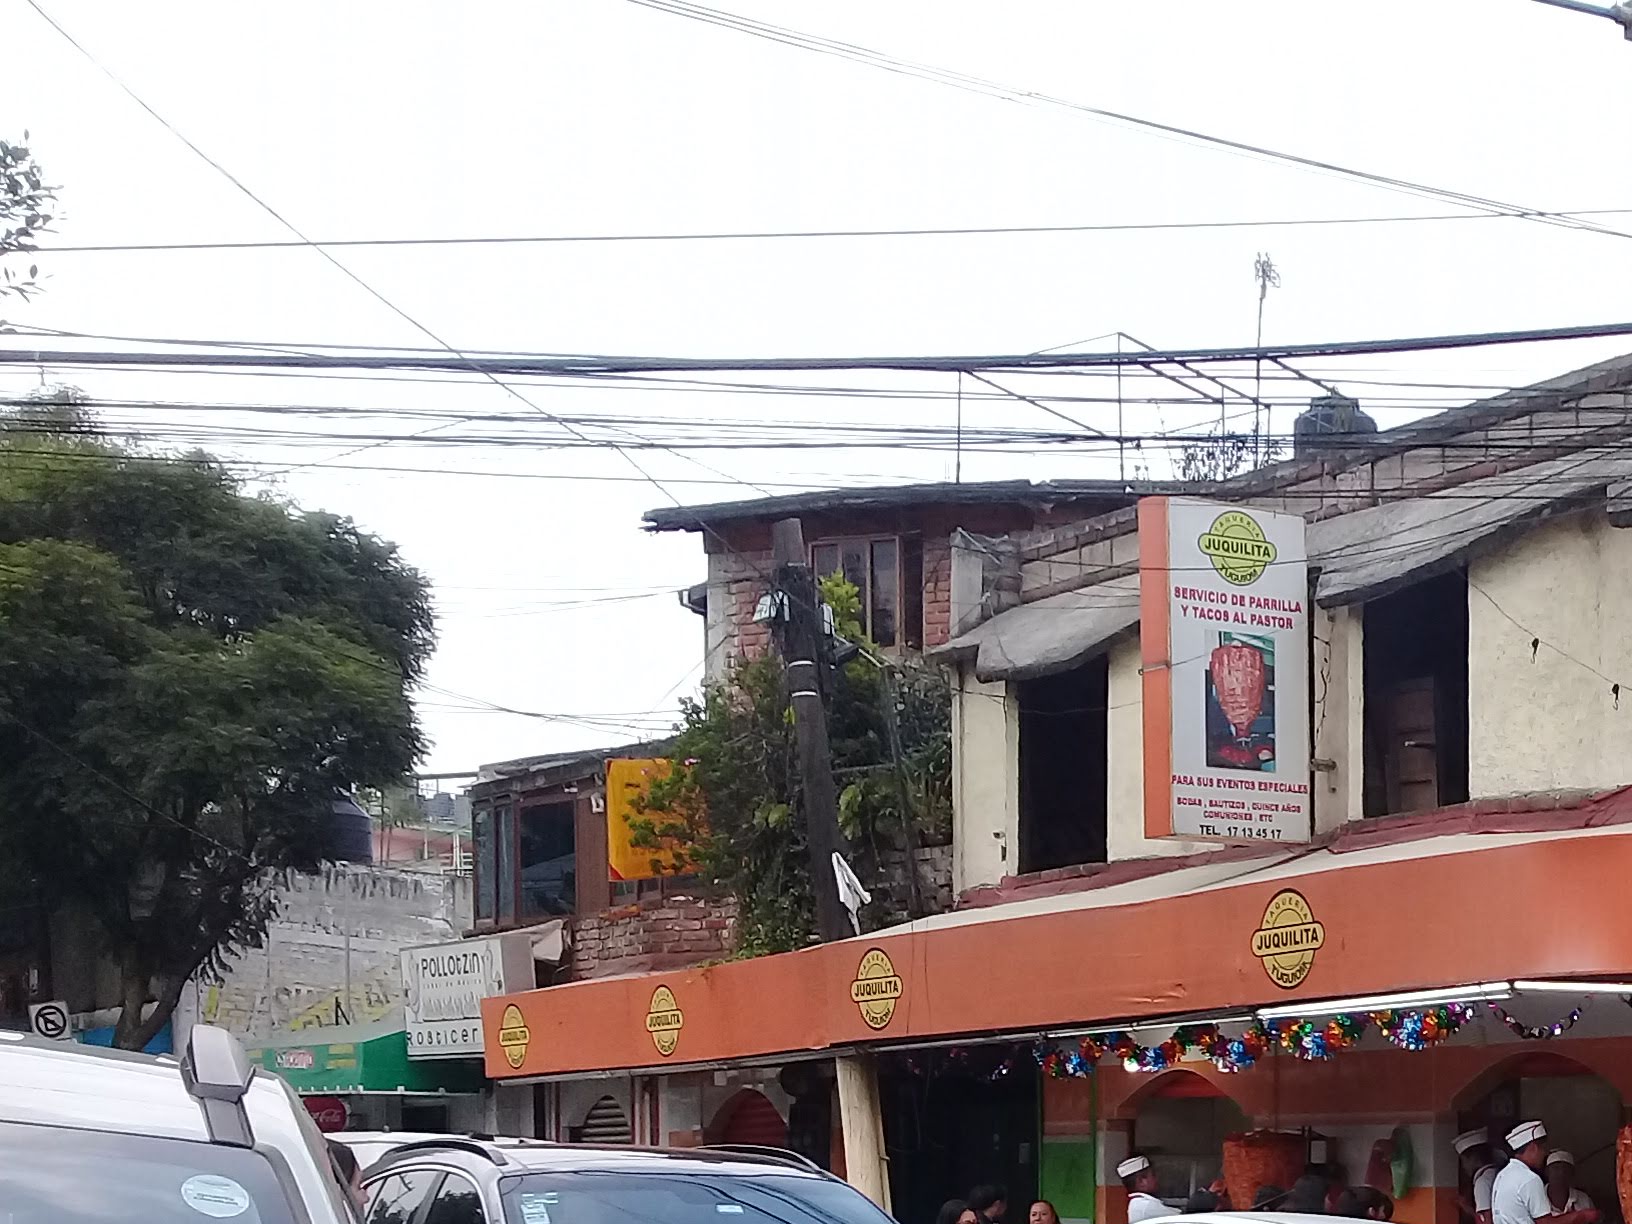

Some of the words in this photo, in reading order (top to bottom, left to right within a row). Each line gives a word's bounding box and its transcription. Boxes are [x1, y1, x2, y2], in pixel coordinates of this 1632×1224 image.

[1204, 538, 1271, 558] JUQUILITA
[1174, 586, 1228, 604] SERVICIO
[1231, 594, 1246, 607] DE
[1249, 597, 1302, 613] PARRILLA
[1181, 605, 1189, 617] Y
[1192, 607, 1229, 621] TACOS
[1233, 612, 1247, 624] AL
[1250, 614, 1293, 629] PASTOR
[1171, 774, 1194, 787] PARA
[1197, 776, 1213, 788] SUS
[1216, 779, 1255, 791] EVENTOS
[1258, 782, 1308, 794] ESPECIALES
[1200, 825, 1220, 836] TEL.
[1227, 826, 1238, 837] 17
[1242, 828, 1253, 838] 13
[1256, 829, 1268, 838] 45
[1271, 830, 1282, 839] 17
[1257, 927, 1319, 950] JUQUILITA
[855, 981, 899, 997] JUQUILITA
